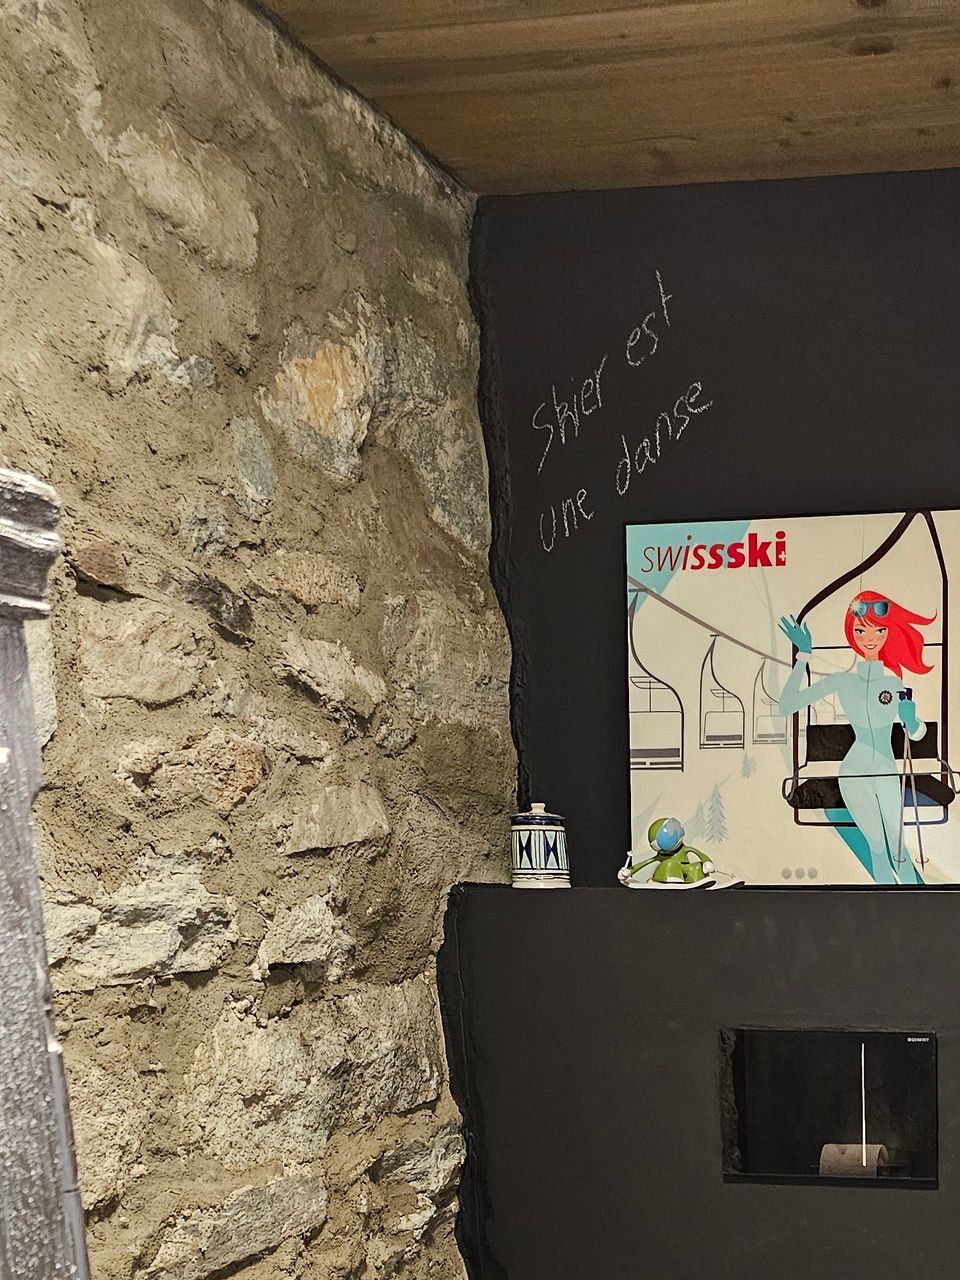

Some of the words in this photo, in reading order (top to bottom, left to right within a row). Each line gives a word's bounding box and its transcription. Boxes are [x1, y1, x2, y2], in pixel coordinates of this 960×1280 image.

[626, 270, 673, 368] est
[540, 488, 595, 552] une
[616, 381, 714, 496] danse
[641, 530, 787, 574] swissski
